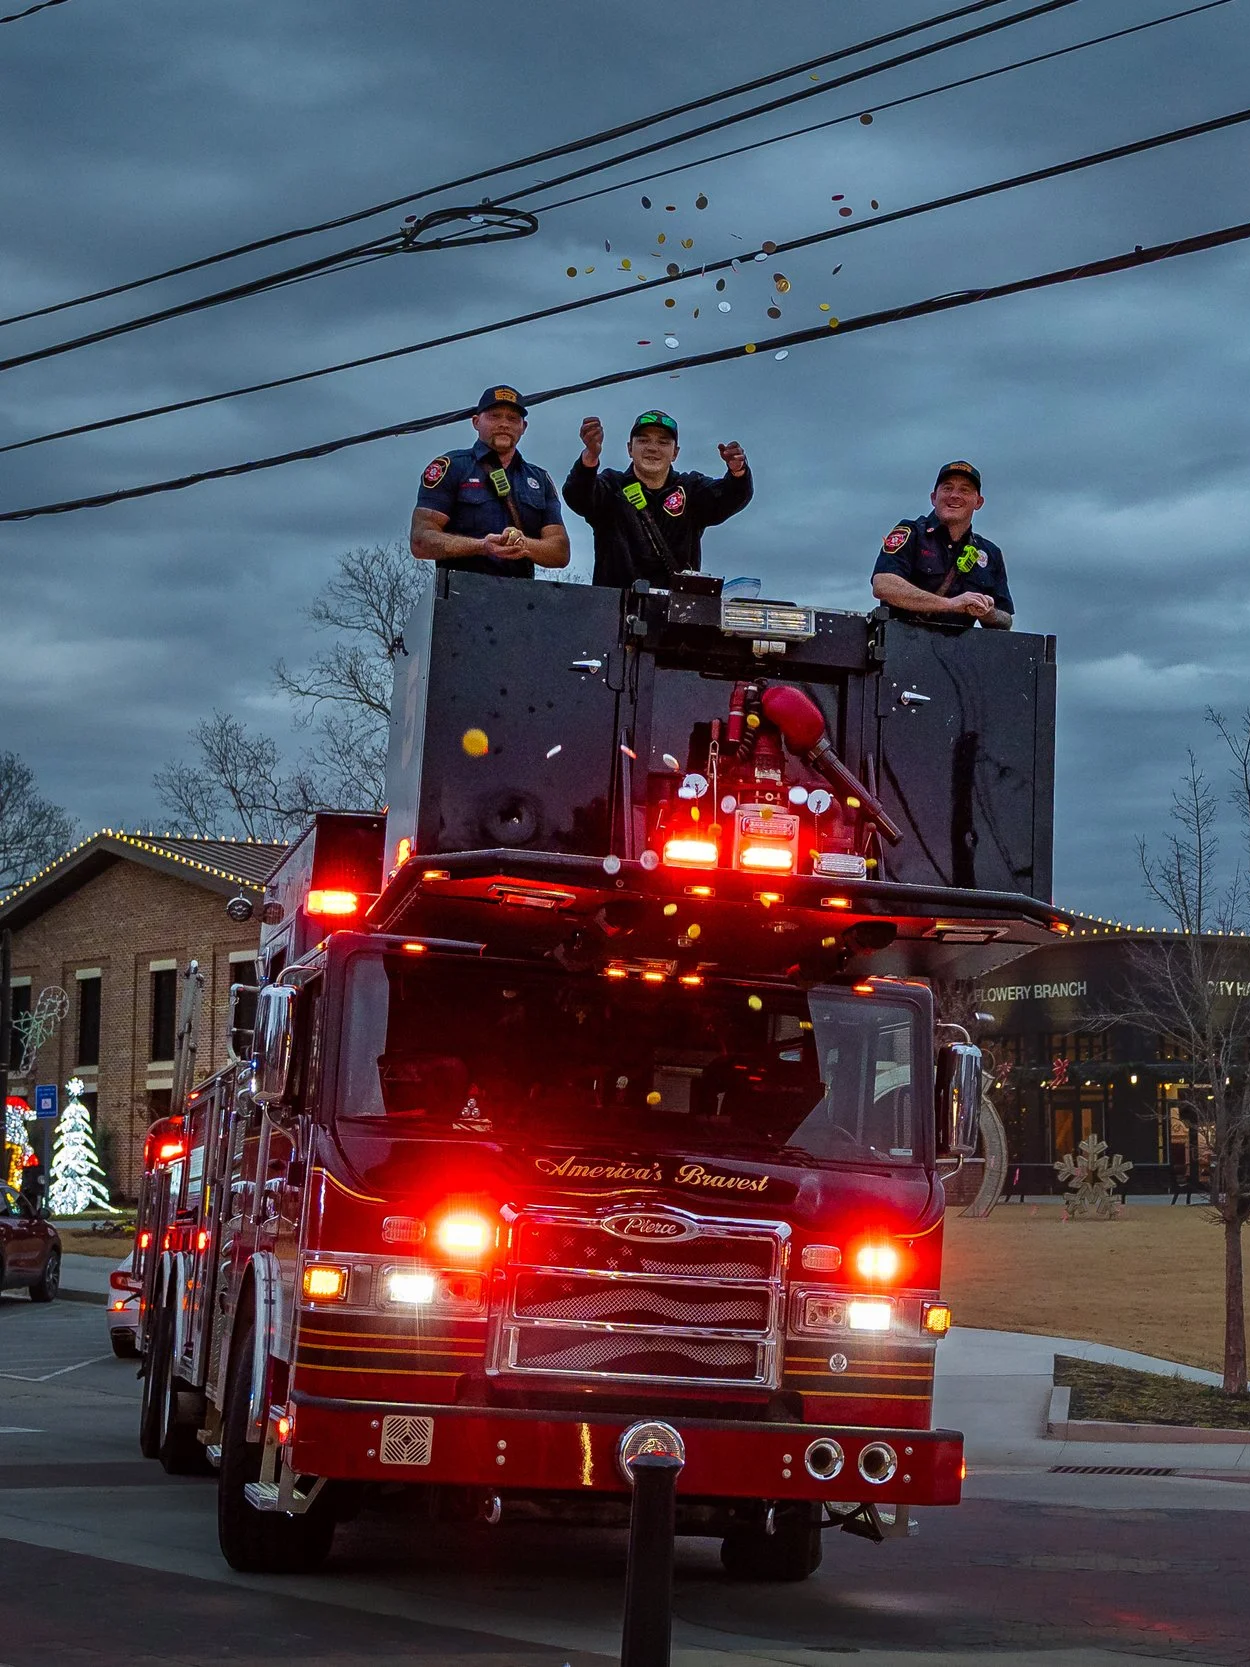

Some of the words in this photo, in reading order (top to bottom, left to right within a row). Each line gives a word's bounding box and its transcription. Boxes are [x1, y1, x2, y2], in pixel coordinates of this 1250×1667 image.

[974, 985, 1031, 1002] FLOWERY
[1034, 981, 1087, 998] BRANCH
[535, 1156, 662, 1181] America's
[674, 1164, 769, 1191] Bravest
[623, 1217, 678, 1235] Pierce
